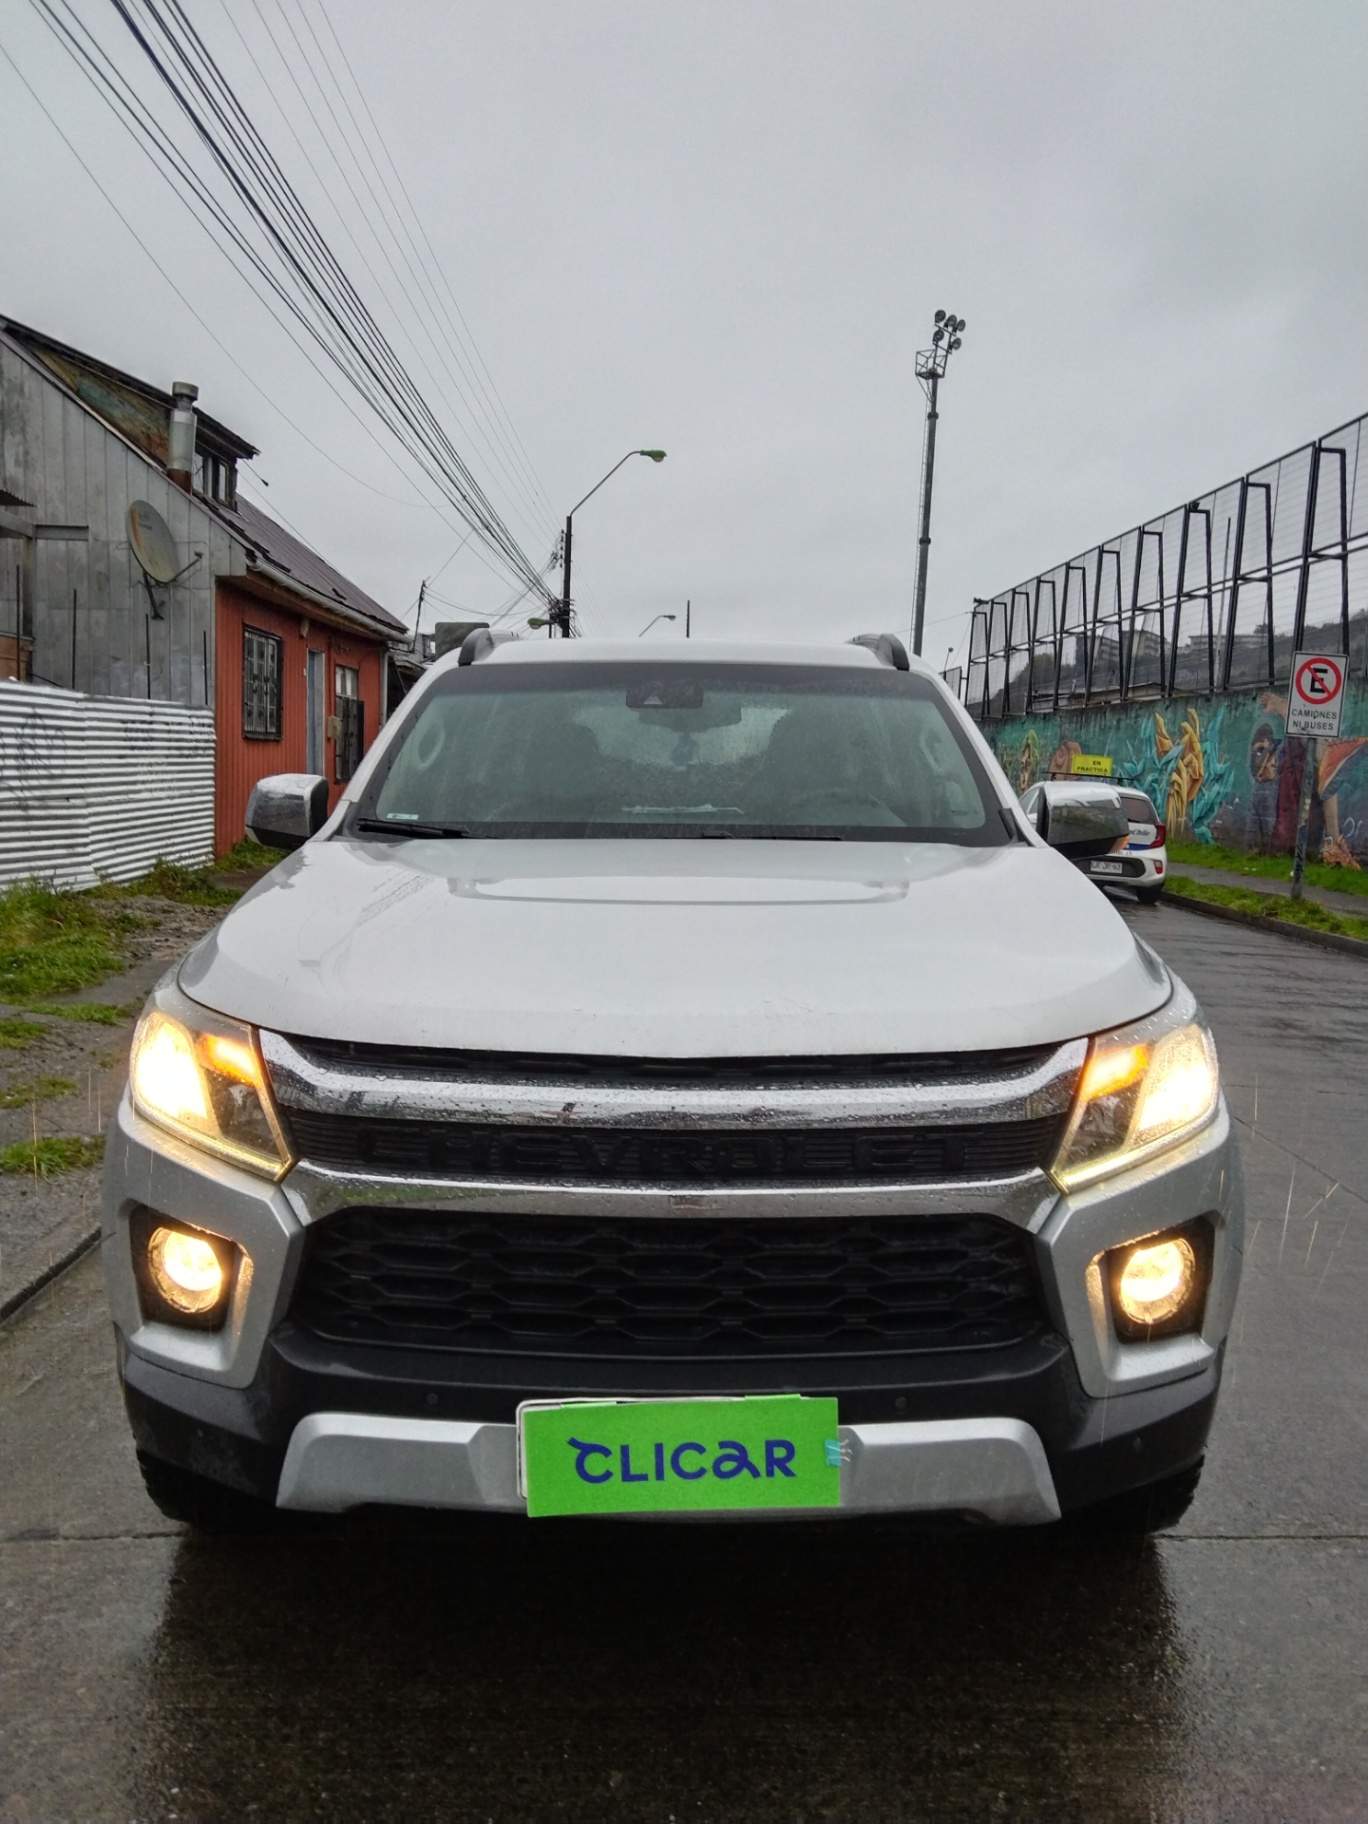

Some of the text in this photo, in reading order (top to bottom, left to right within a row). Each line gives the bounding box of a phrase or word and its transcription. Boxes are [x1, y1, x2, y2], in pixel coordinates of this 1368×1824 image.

[1291, 708, 1337, 720] CAMIONES
[1292, 720, 1334, 730] NI BUSES
[358, 1126, 984, 1173] CHEVROLET
